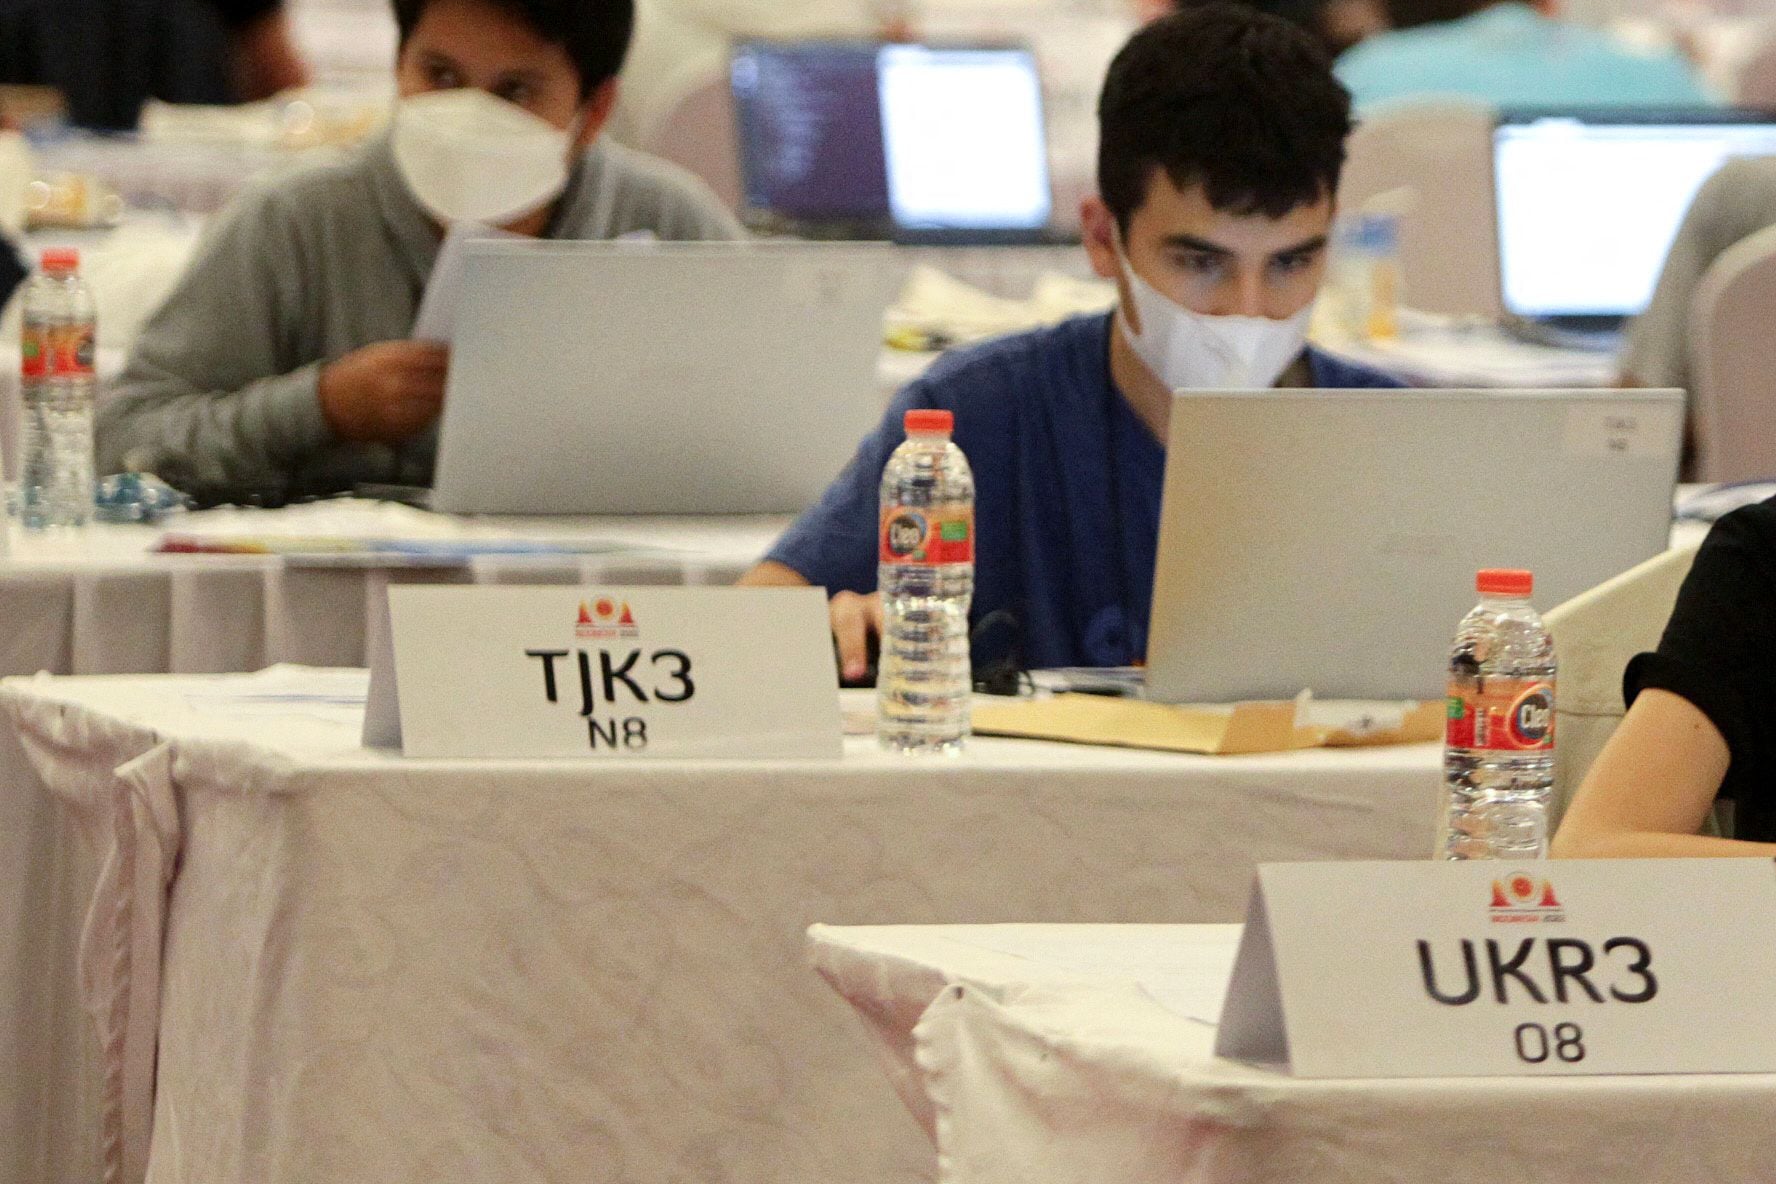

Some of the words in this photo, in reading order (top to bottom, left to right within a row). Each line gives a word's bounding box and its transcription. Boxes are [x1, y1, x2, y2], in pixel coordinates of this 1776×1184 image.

[525, 648, 696, 716] TJK3
[588, 716, 648, 750] N8
[1416, 936, 1660, 1006] UKR3
